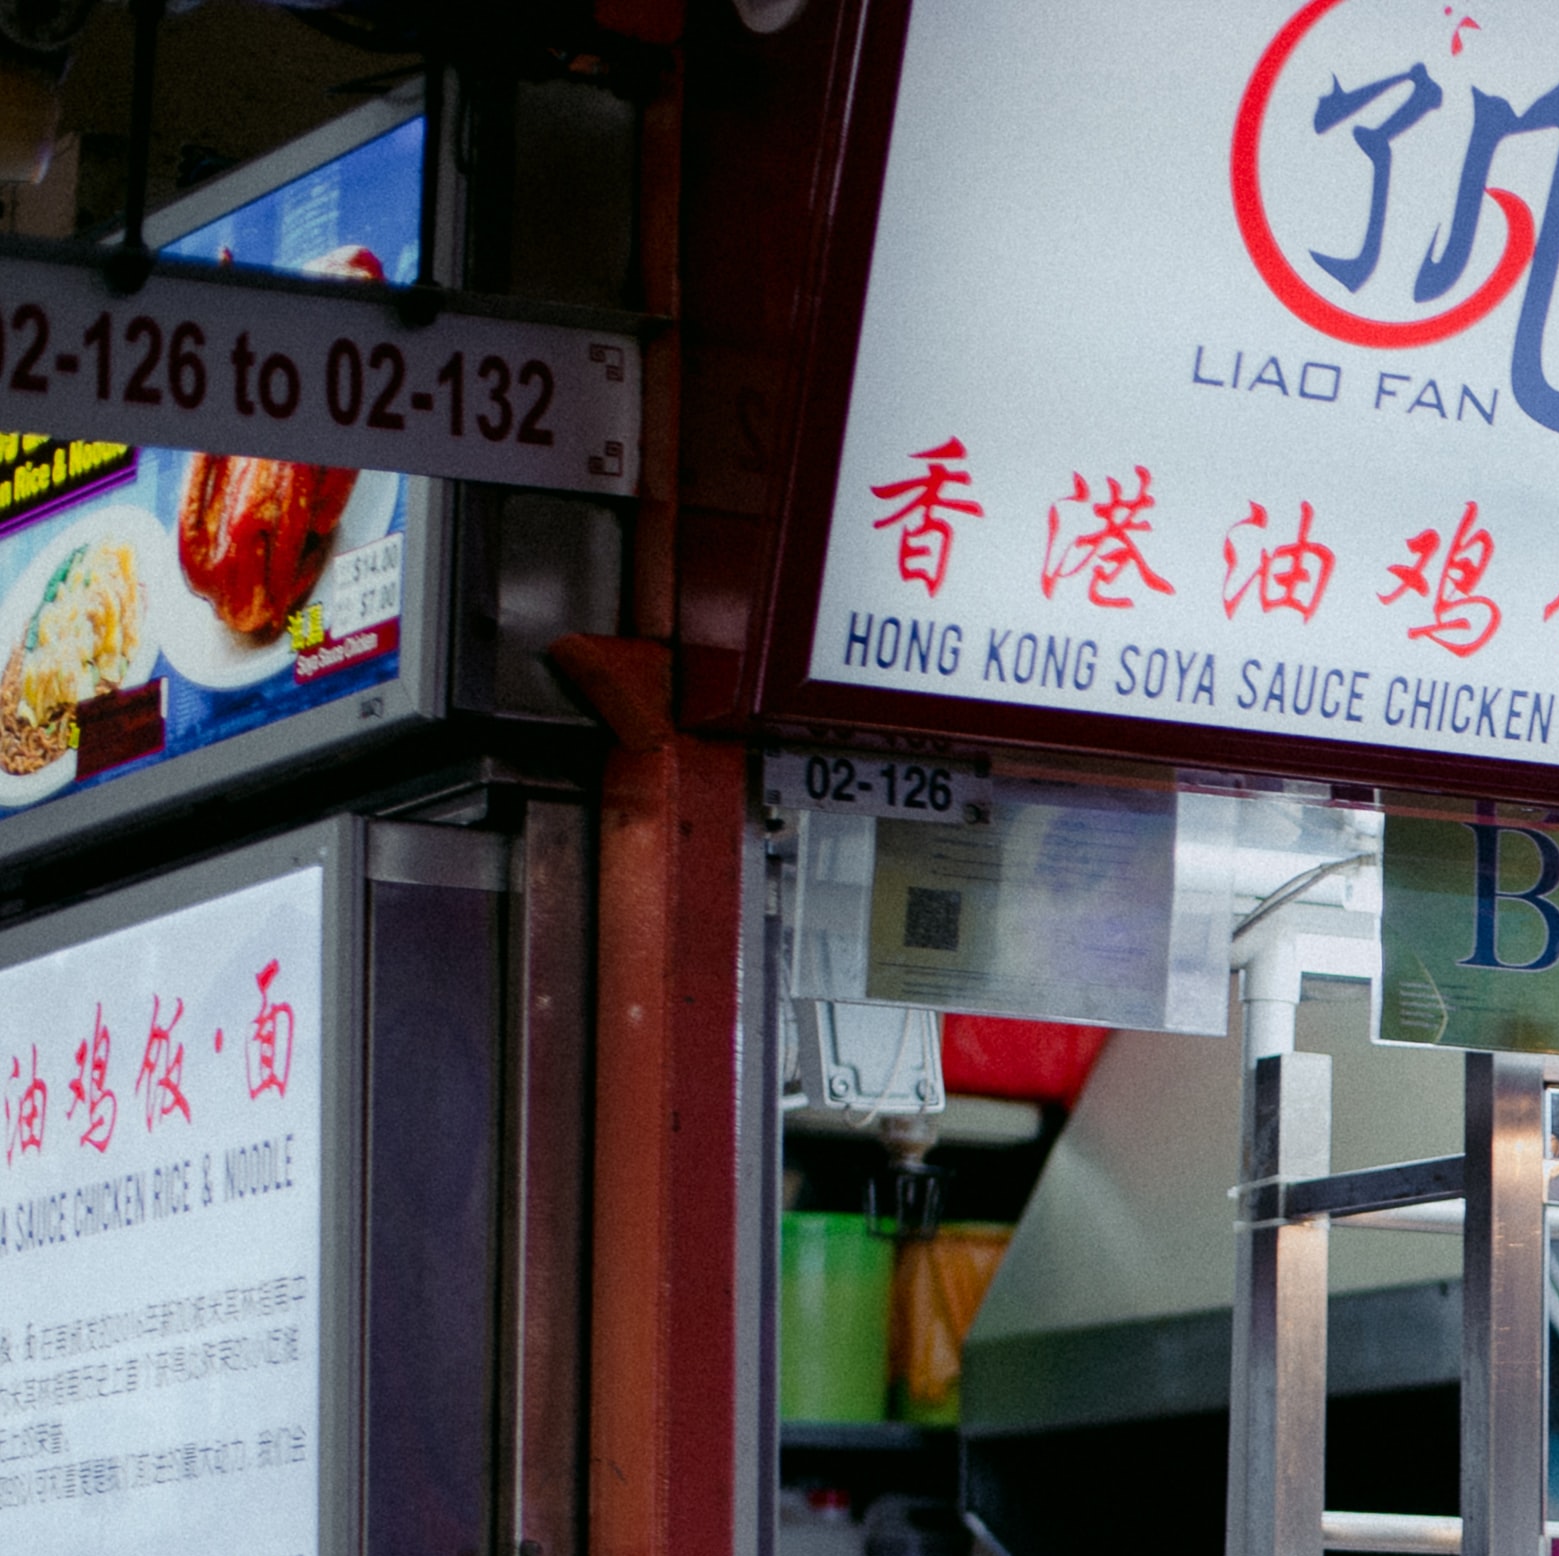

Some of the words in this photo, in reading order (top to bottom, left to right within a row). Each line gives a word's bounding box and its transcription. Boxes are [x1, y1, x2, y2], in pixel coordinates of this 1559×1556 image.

[230, 331, 299, 419] to
[325, 337, 555, 447] 02-132
[1190, 345, 1341, 402] LIAO
[1373, 372, 1499, 427] FAN
[14, 461, 51, 501] Rice
[844, 611, 964, 676] HONG
[983, 627, 1099, 692] KONG
[1115, 643, 1217, 706] SOYA
[1236, 658, 1370, 723] SAUCE
[1384, 676, 1554, 744] CHICKEN
[806, 756, 951, 811] 02-126
[15, 1193, 66, 1253] SAUCE
[74, 1174, 145, 1237] CHICKEN
[153, 1160, 191, 1219] RICE
[226, 1133, 294, 1202] NOODLE
